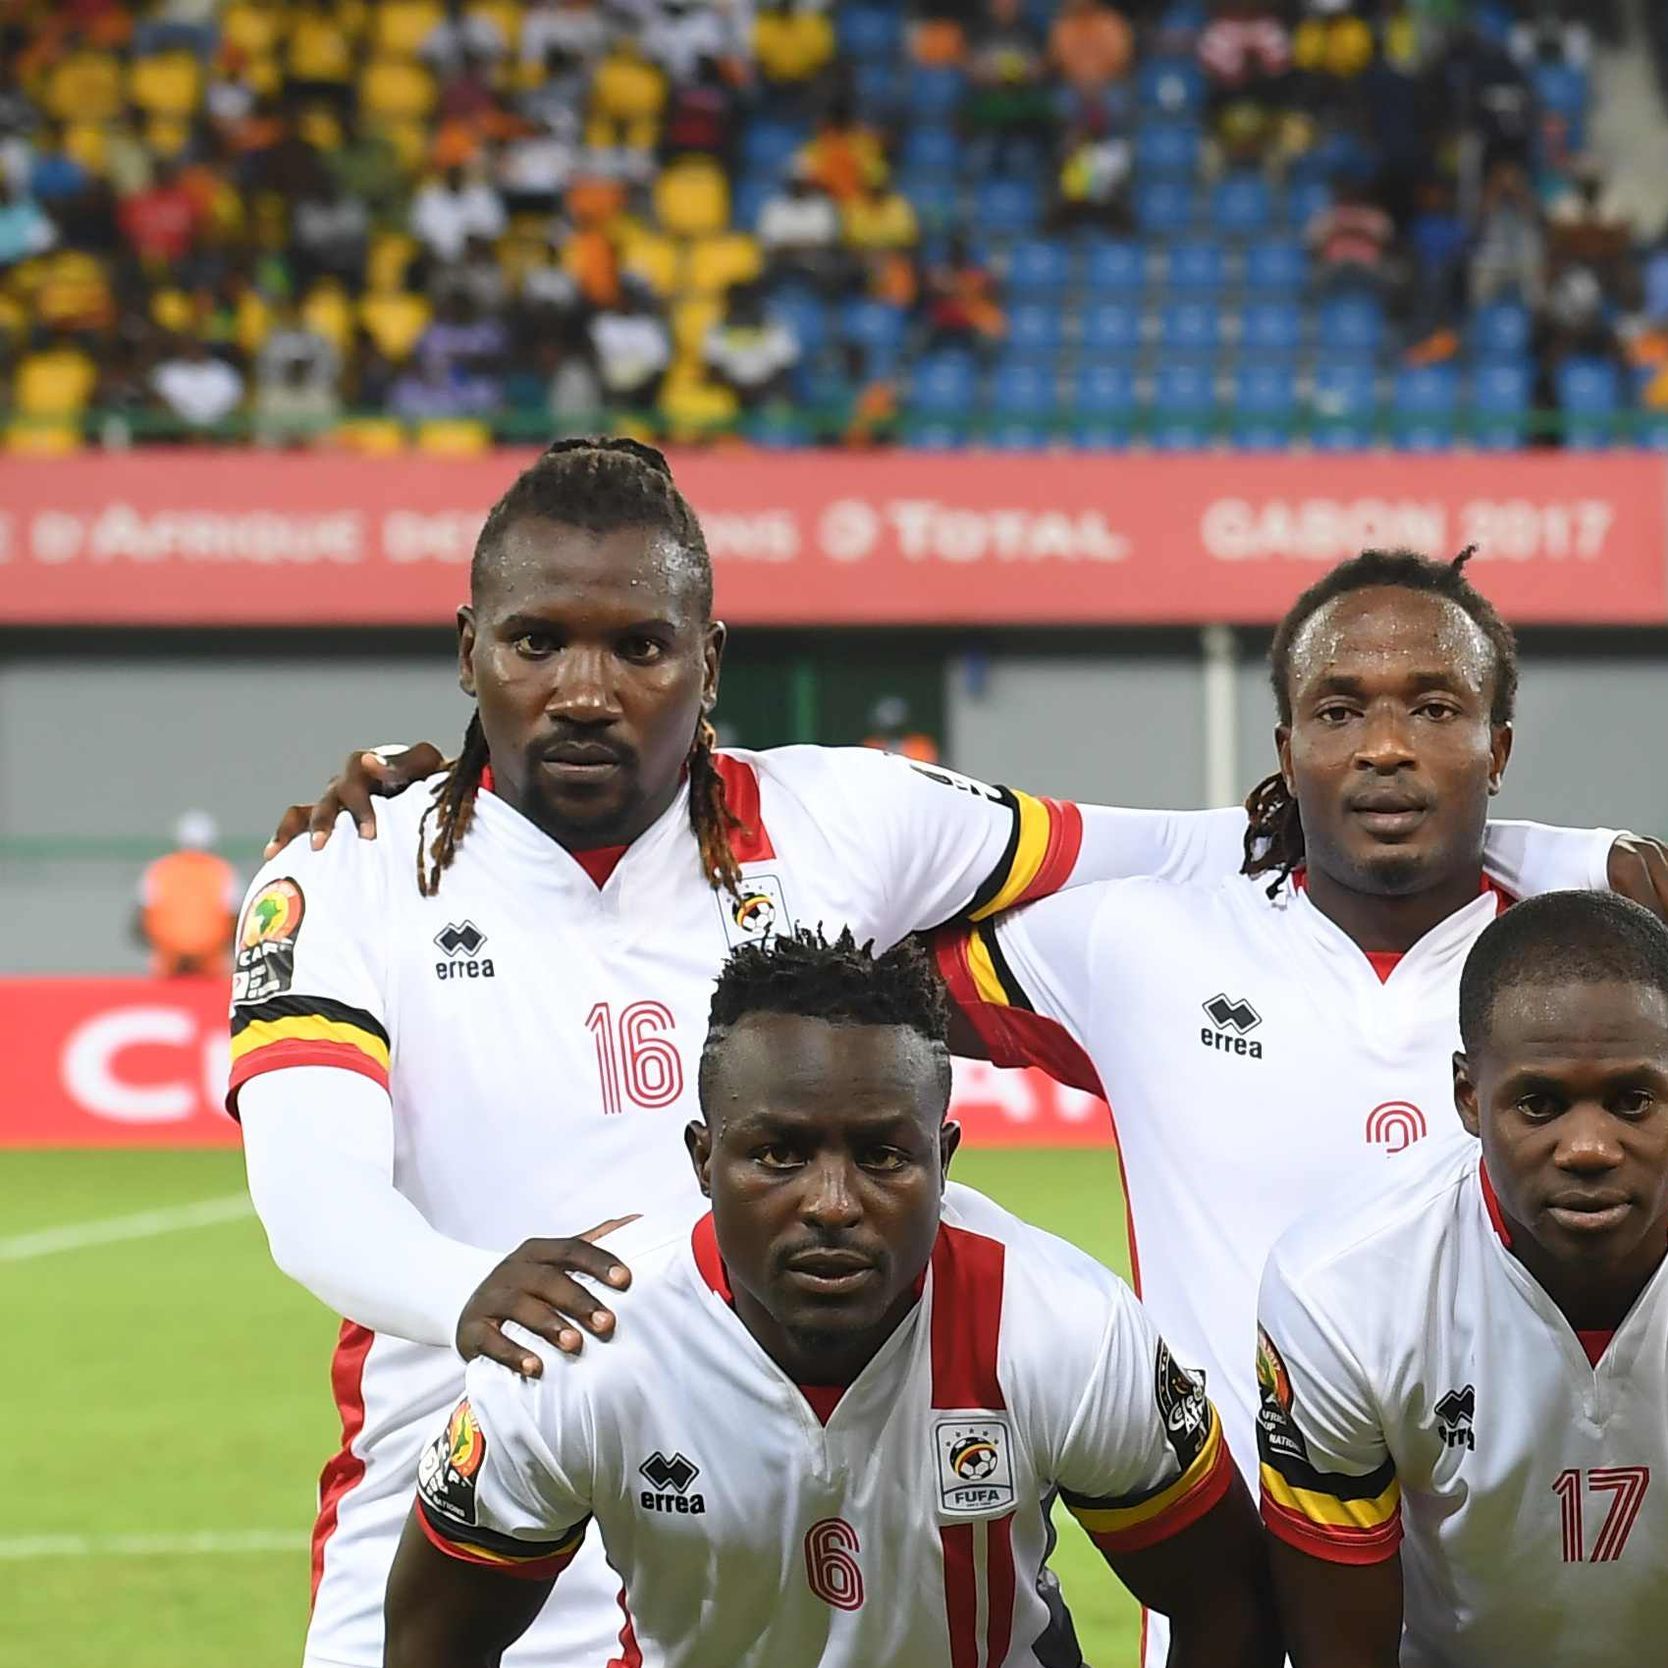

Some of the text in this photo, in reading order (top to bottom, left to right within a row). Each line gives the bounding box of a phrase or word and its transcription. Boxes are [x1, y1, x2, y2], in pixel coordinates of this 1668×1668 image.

[1201, 497, 1614, 560] GABON 2017
[435, 958, 495, 981] errea
[585, 1000, 684, 1115] 16
[1200, 1027, 1263, 1060] errea
[640, 1491, 706, 1515] errea
[954, 1488, 1001, 1504] FUFA
[1551, 1466, 1650, 1563] 17
[804, 1516, 865, 1612] 6
